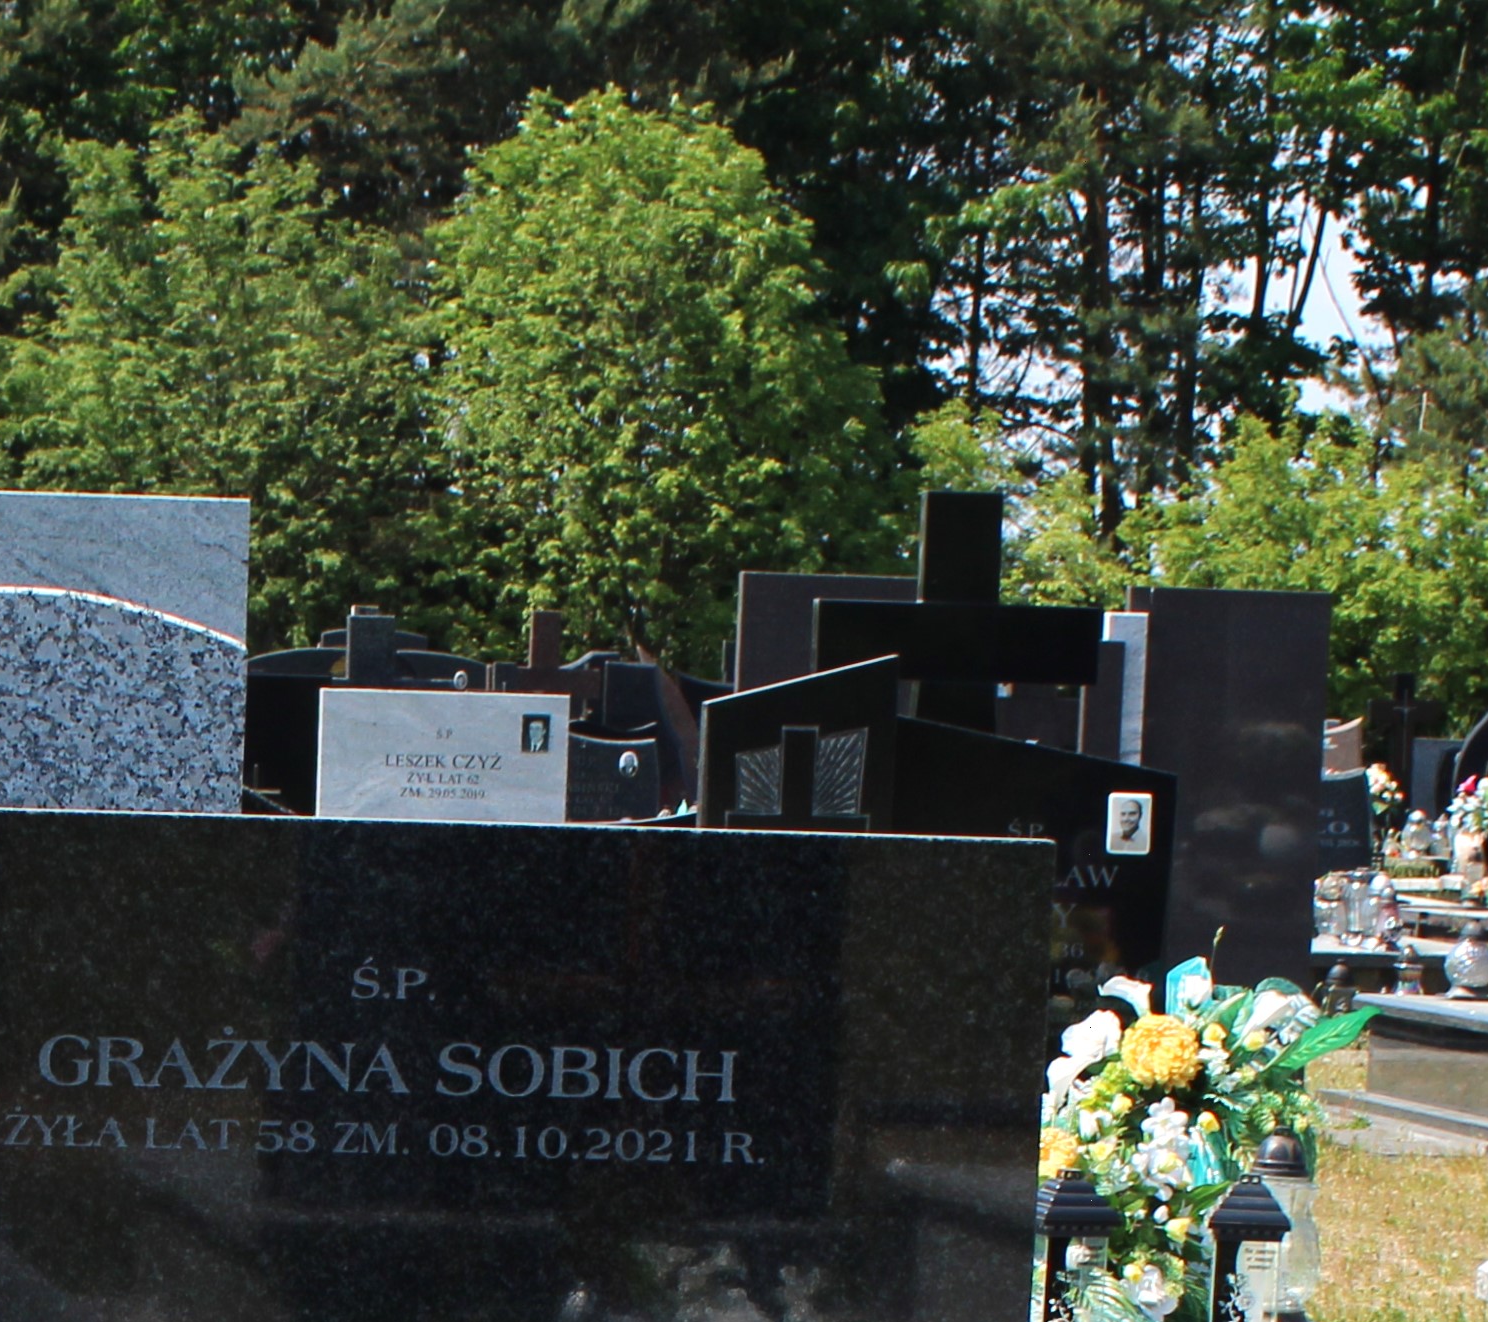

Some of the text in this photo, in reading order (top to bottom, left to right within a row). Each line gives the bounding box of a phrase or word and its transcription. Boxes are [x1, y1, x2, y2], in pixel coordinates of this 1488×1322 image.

[384, 752, 503, 771] LESZEK CZYŻ
[439, 773, 464, 785] LAT
[351, 955, 437, 1001] Ś.P.
[37, 1025, 739, 1103] GRAŻYNA SOBICH
[3, 1105, 127, 1149] ŻYŁA
[144, 1117, 241, 1151] LAT
[254, 1119, 317, 1153] 58
[332, 1121, 410, 1156] ZM.
[722, 1131, 765, 1165] R.
